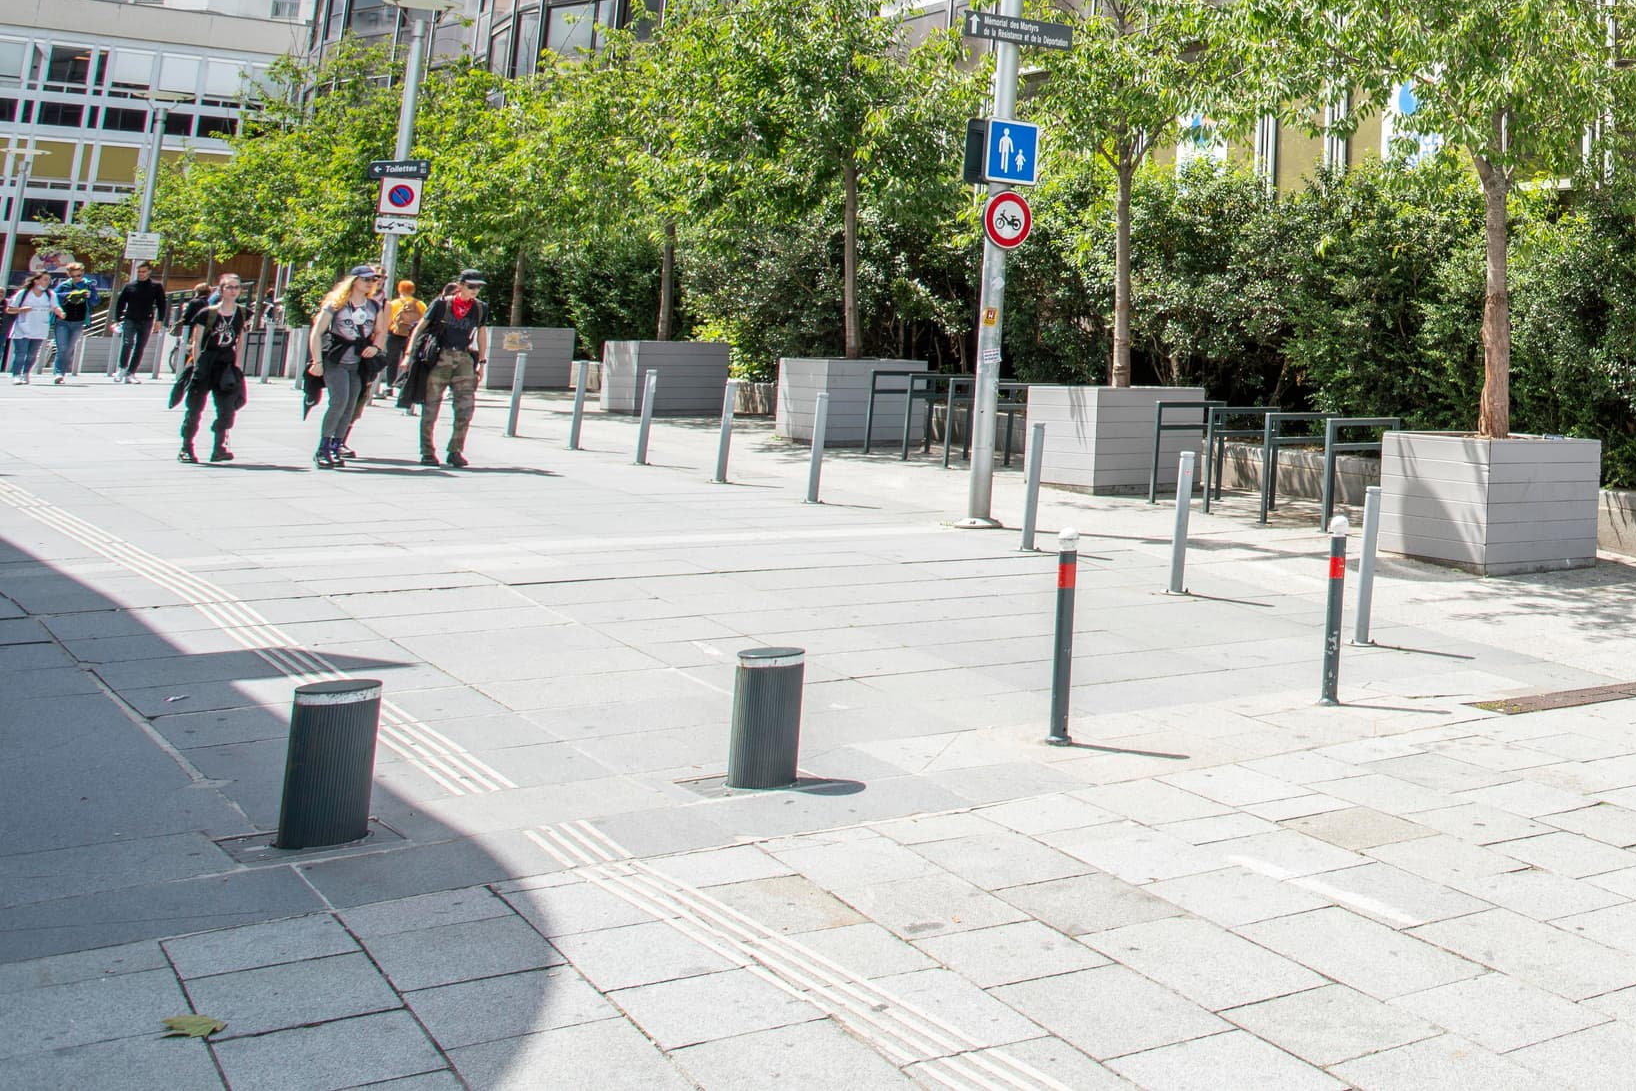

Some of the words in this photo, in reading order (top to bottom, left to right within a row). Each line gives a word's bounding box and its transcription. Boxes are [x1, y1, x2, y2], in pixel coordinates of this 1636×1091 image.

[983, 15, 1008, 28] Mémorial
[1009, 21, 1020, 29] des
[1020, 21, 1039, 33] Martyrs
[983, 28, 990, 36] de
[991, 28, 997, 36] la
[998, 29, 1023, 41] Résistance
[1043, 35, 1069, 47] Déportation
[385, 165, 418, 173] Toilettes
